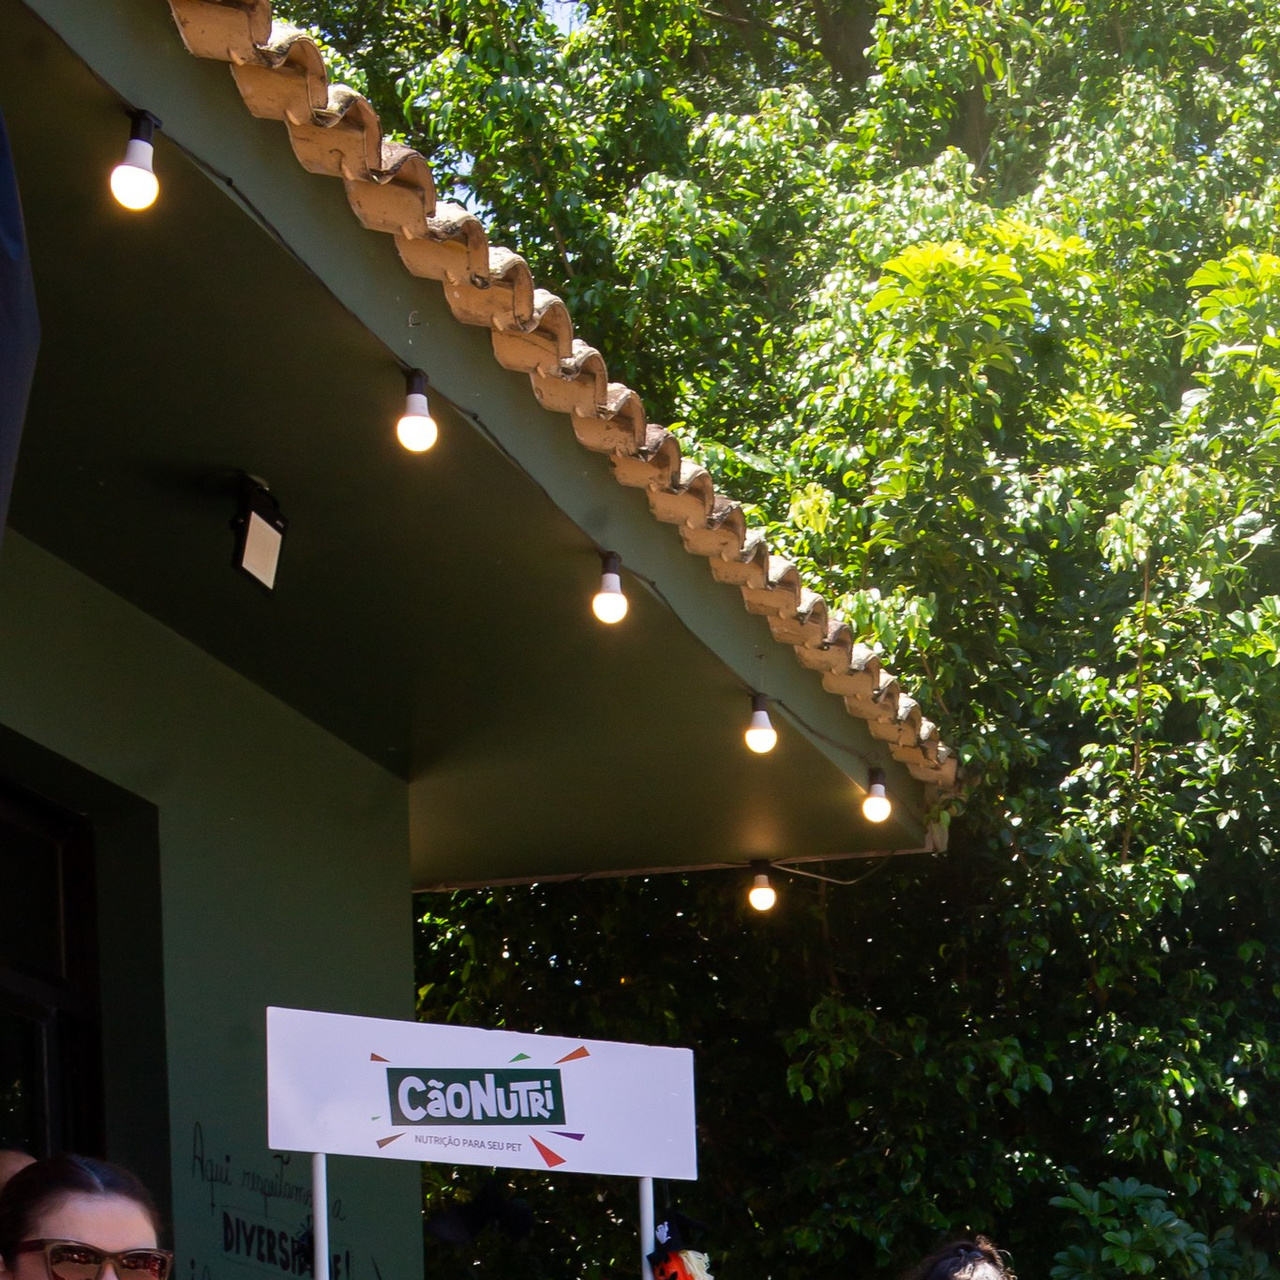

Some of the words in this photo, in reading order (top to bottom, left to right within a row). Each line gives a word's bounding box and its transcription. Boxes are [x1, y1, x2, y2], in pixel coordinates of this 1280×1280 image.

[191, 1120, 231, 1215] Aqui
[414, 1134, 460, 1148] NUTRIÇÃO
[462, 1138, 486, 1148] PARA
[488, 1142, 504, 1151] SEU
[506, 1143, 522, 1152] PET
